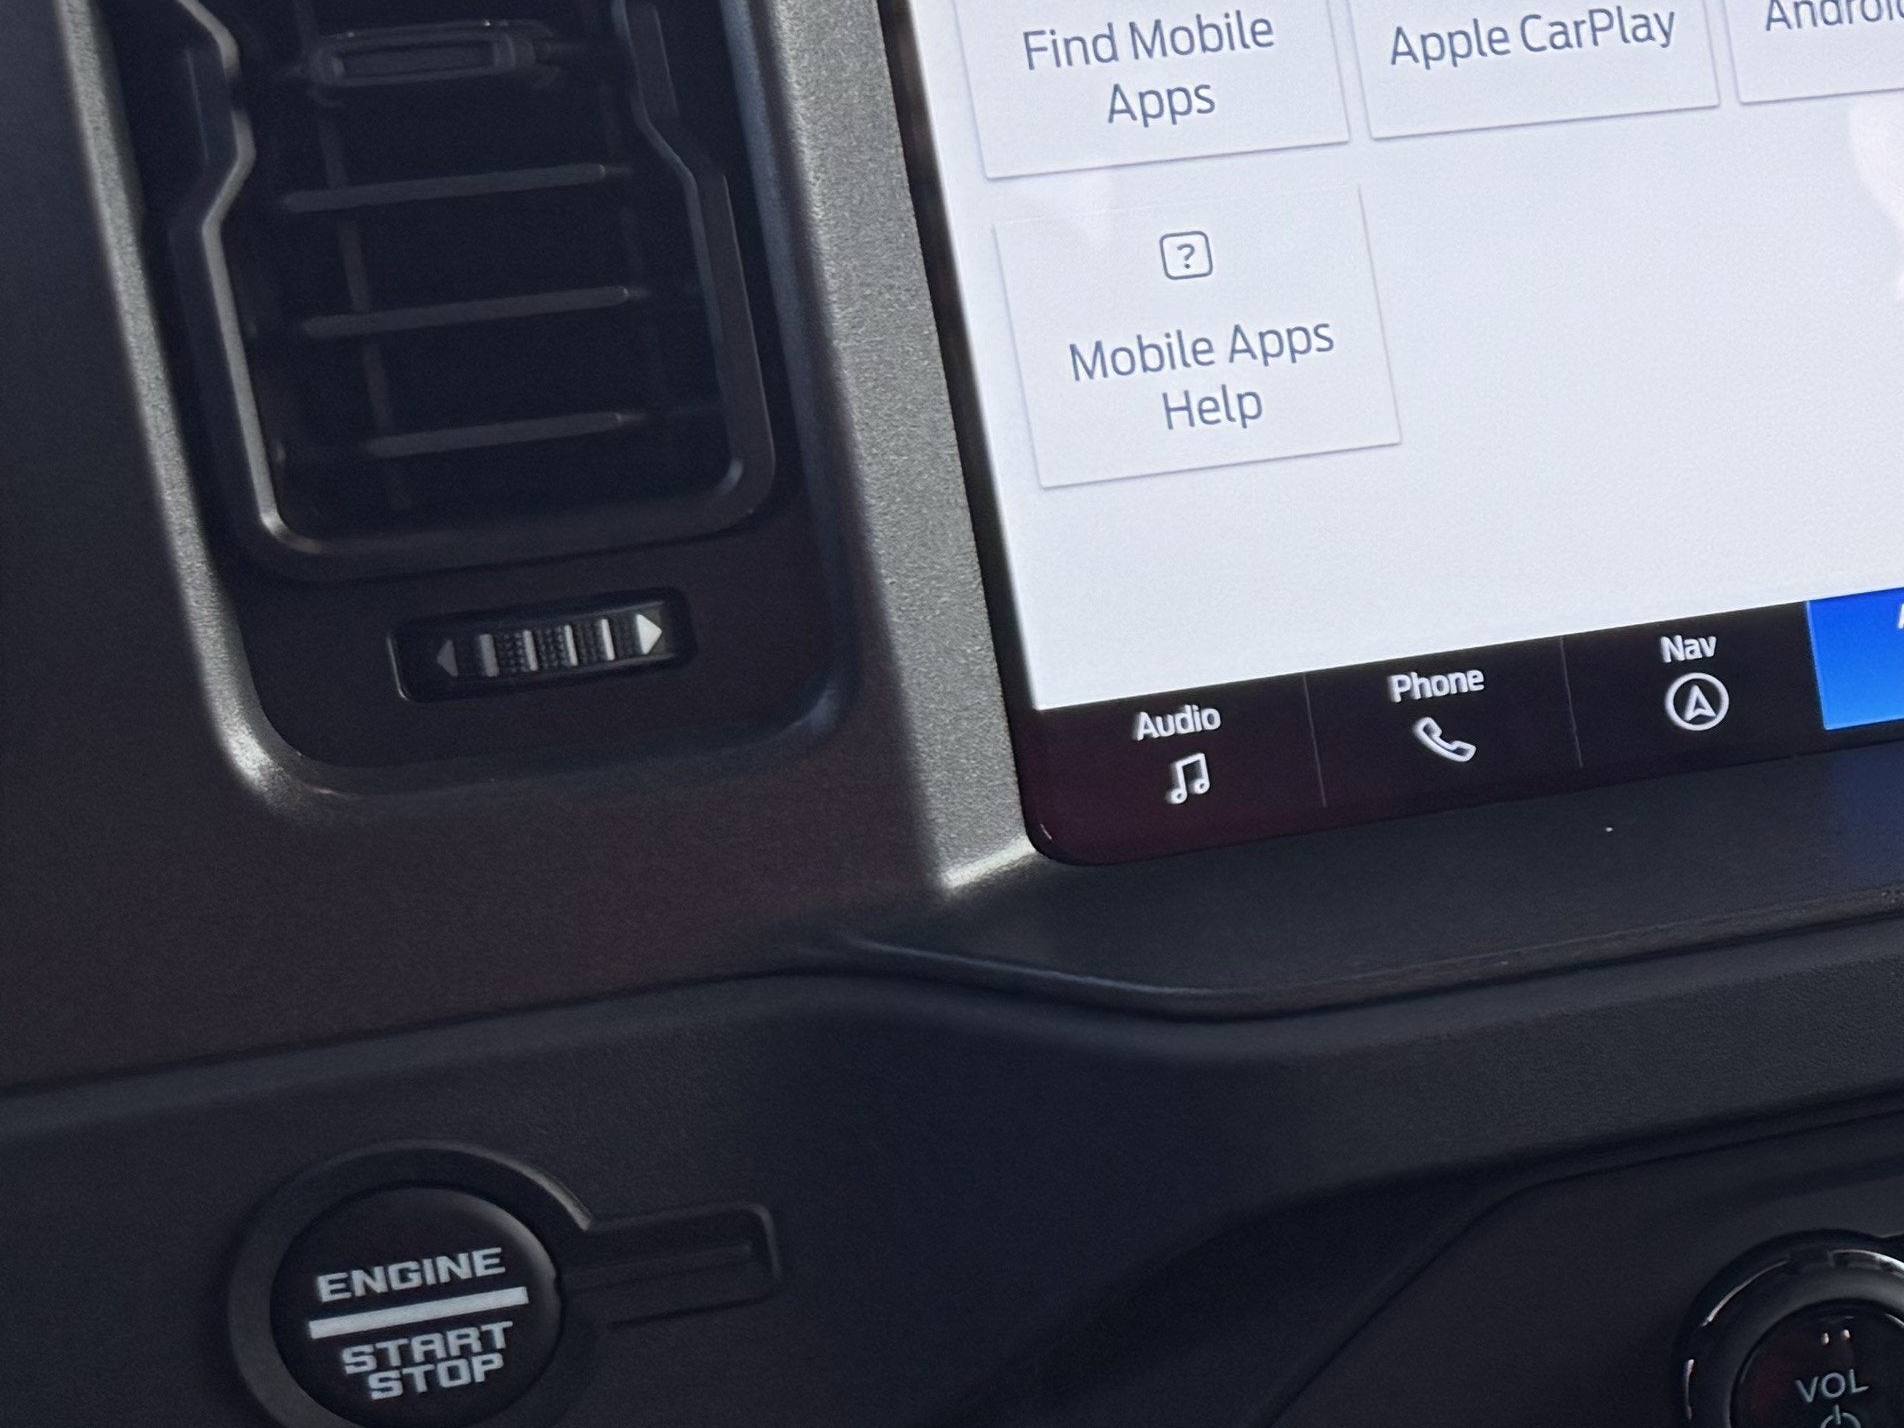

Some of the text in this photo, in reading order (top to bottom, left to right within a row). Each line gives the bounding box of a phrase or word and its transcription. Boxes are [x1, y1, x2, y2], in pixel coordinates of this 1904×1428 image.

[1023, 10, 1275, 71] Find Mobile
[1389, 5, 1677, 71] Apple CarPlay
[1105, 78, 1216, 129] Apps
[1069, 317, 1335, 382] Mobile Apps
[1162, 383, 1264, 432] Help
[1660, 633, 1718, 665] Nav
[1387, 666, 1485, 704] Phone
[1135, 703, 1222, 741] Audio
[316, 1247, 506, 1303] ENGINE
[340, 1320, 513, 1375] START
[367, 1353, 504, 1402] STOP
[1796, 1368, 1870, 1406] VOL
